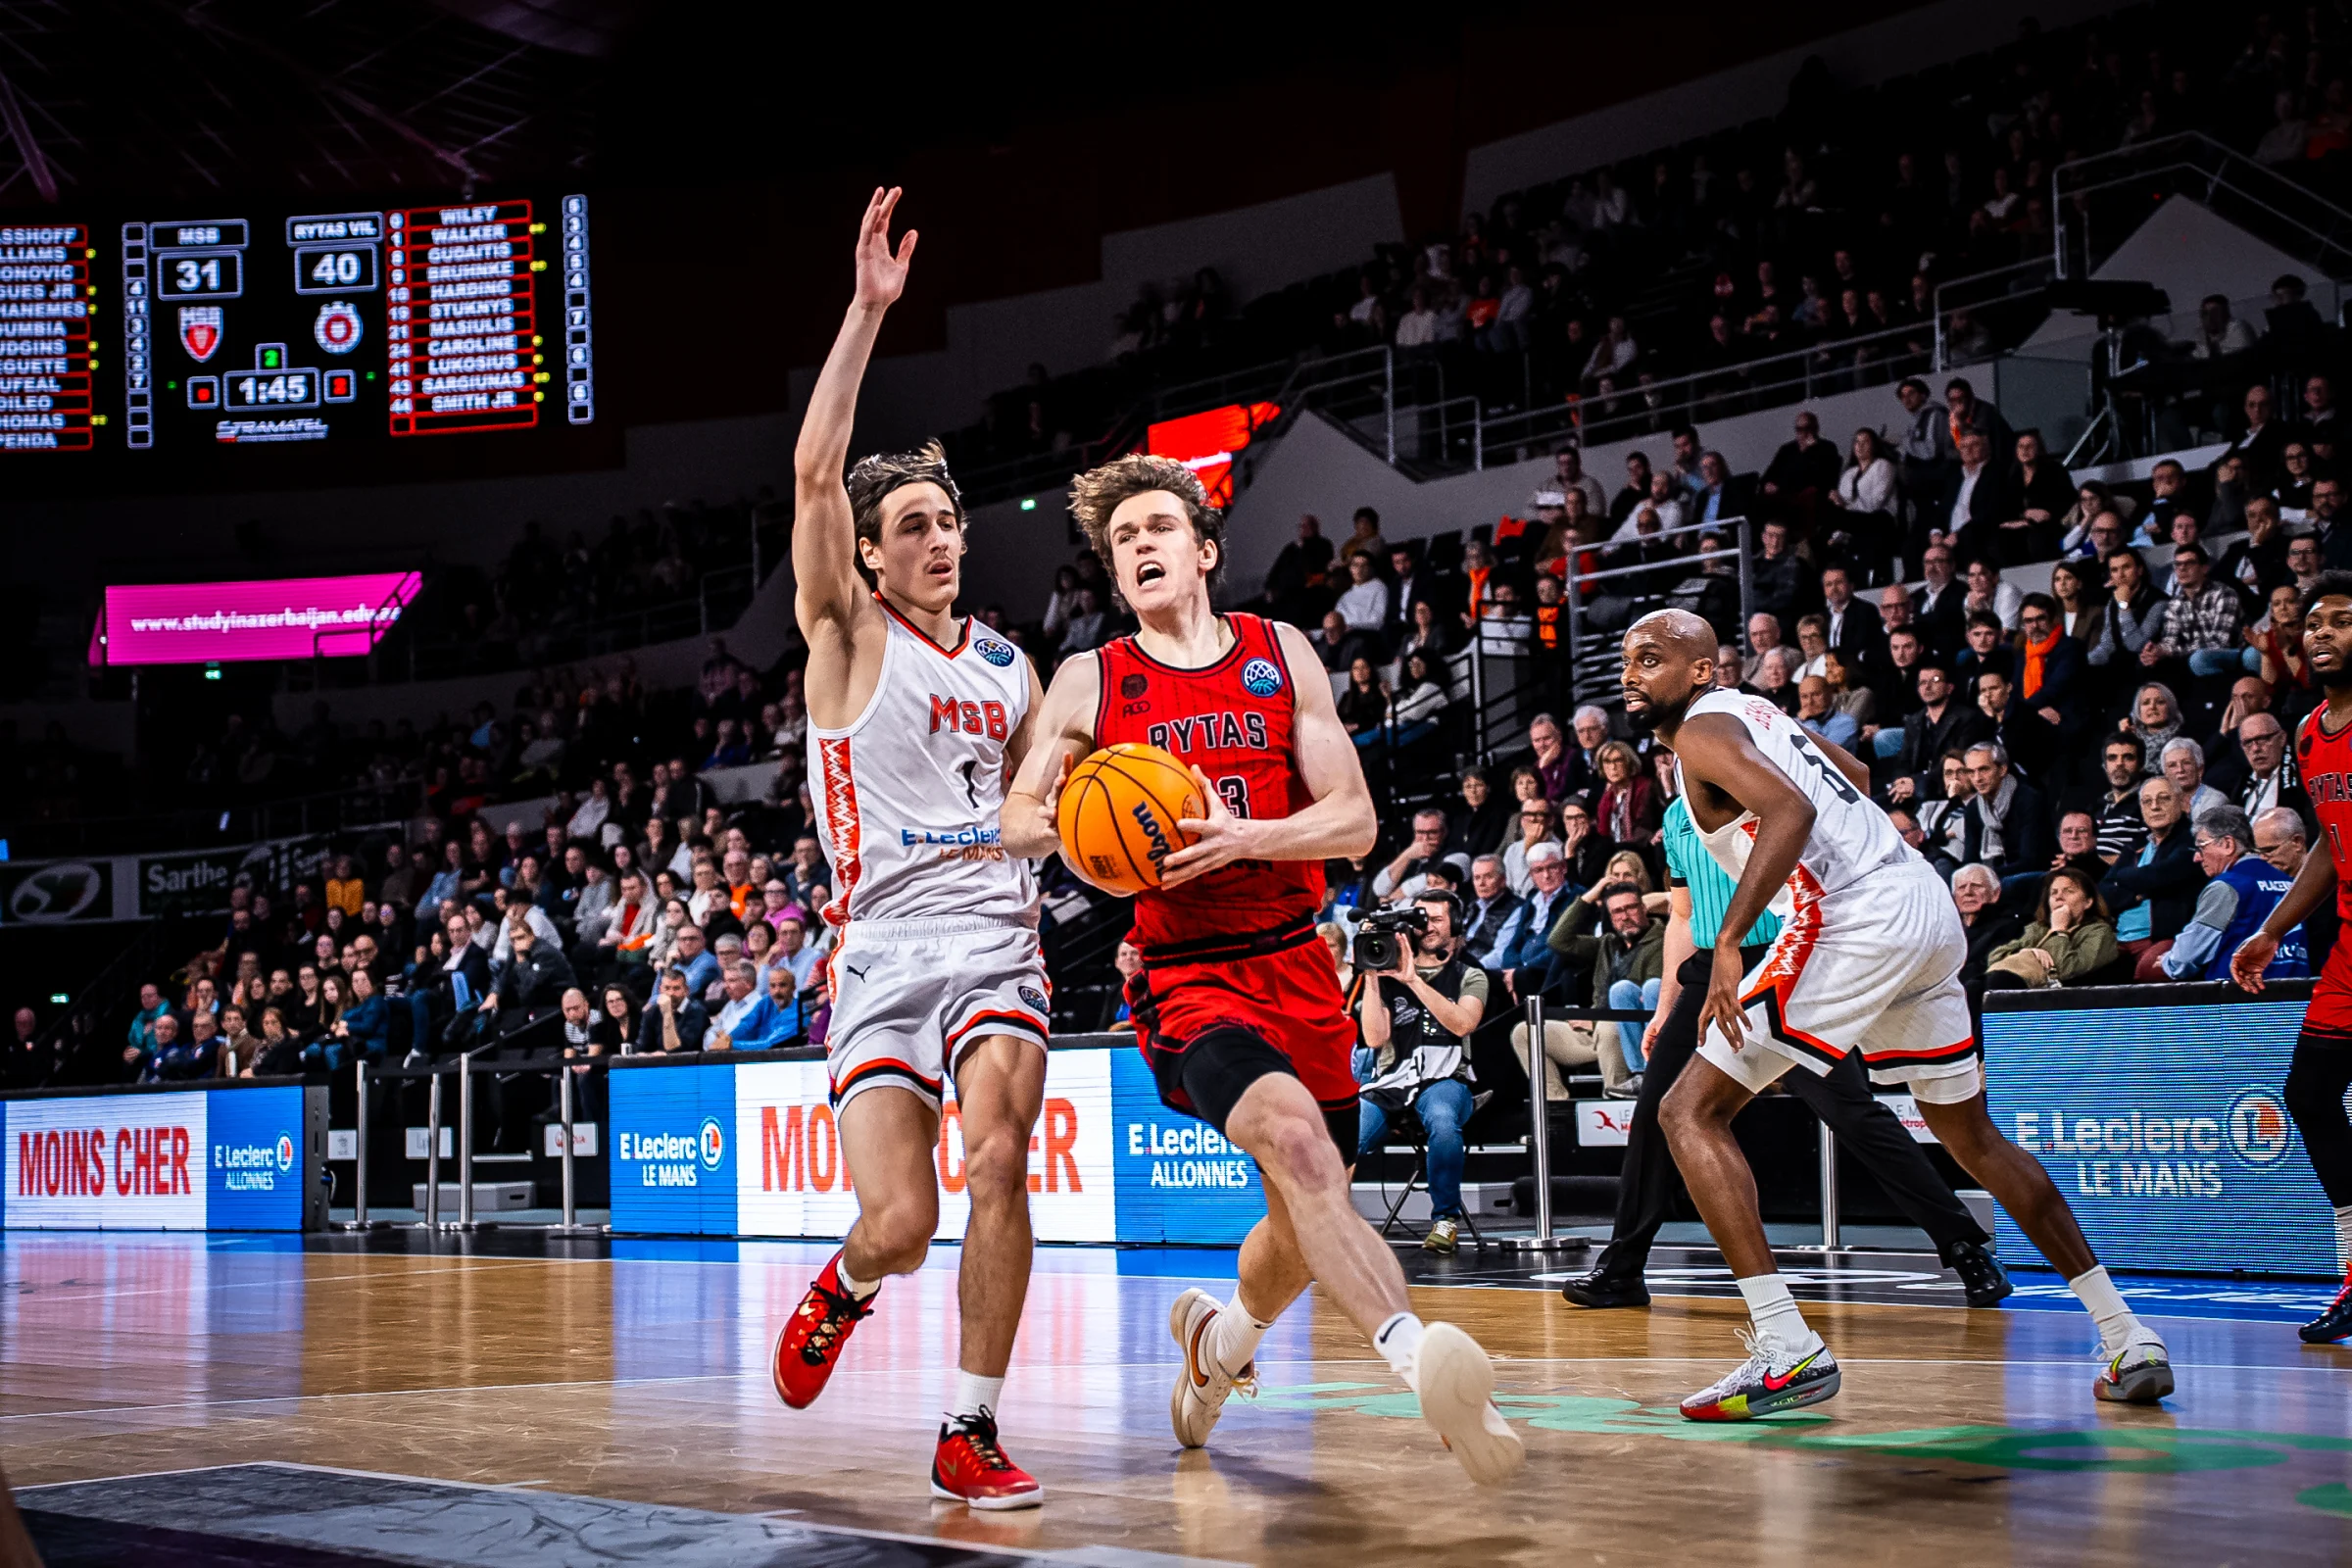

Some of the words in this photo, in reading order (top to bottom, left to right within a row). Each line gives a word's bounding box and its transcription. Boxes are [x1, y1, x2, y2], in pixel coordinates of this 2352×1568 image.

[440, 205, 498, 225] WILEY
[0, 228, 76, 244] SSHOFF
[177, 227, 220, 244] MSB
[294, 222, 347, 239] RYTAS
[391, 231, 403, 247] 1
[431, 223, 508, 245] WALKER
[568, 234, 582, 251] 4
[175, 260, 220, 291] 31
[312, 253, 361, 284] 40
[129, 281, 143, 295] 4
[430, 279, 512, 301] HARDING
[570, 272, 583, 288] 4
[49, 283, 75, 299] JR
[128, 300, 146, 314] 11
[571, 311, 584, 326] 7
[131, 336, 144, 351] 4
[389, 342, 412, 359] 24
[427, 334, 517, 357] CAROLINE
[0, 358, 68, 374] GUETE
[389, 361, 411, 376] 41
[131, 373, 144, 389] 7
[239, 375, 308, 404] 1:45
[431, 394, 489, 413] SMITH
[217, 418, 328, 435] STRAMATEL
[929, 694, 1007, 743] MSB
[1148, 710, 1269, 754] RYTAS
[148, 859, 229, 894] Sarthe
[2015, 1110, 2222, 1153] E.Leclerc
[19, 1128, 106, 1197] MOINS
[116, 1126, 191, 1196] CHER
[224, 1170, 274, 1191] ALLONNES
[642, 1163, 657, 1187] LE
[658, 1163, 698, 1187] MANS
[1150, 1159, 1250, 1189] ALLONNES
[2077, 1159, 2113, 1198] LE
[2119, 1159, 2224, 1199] MANS
